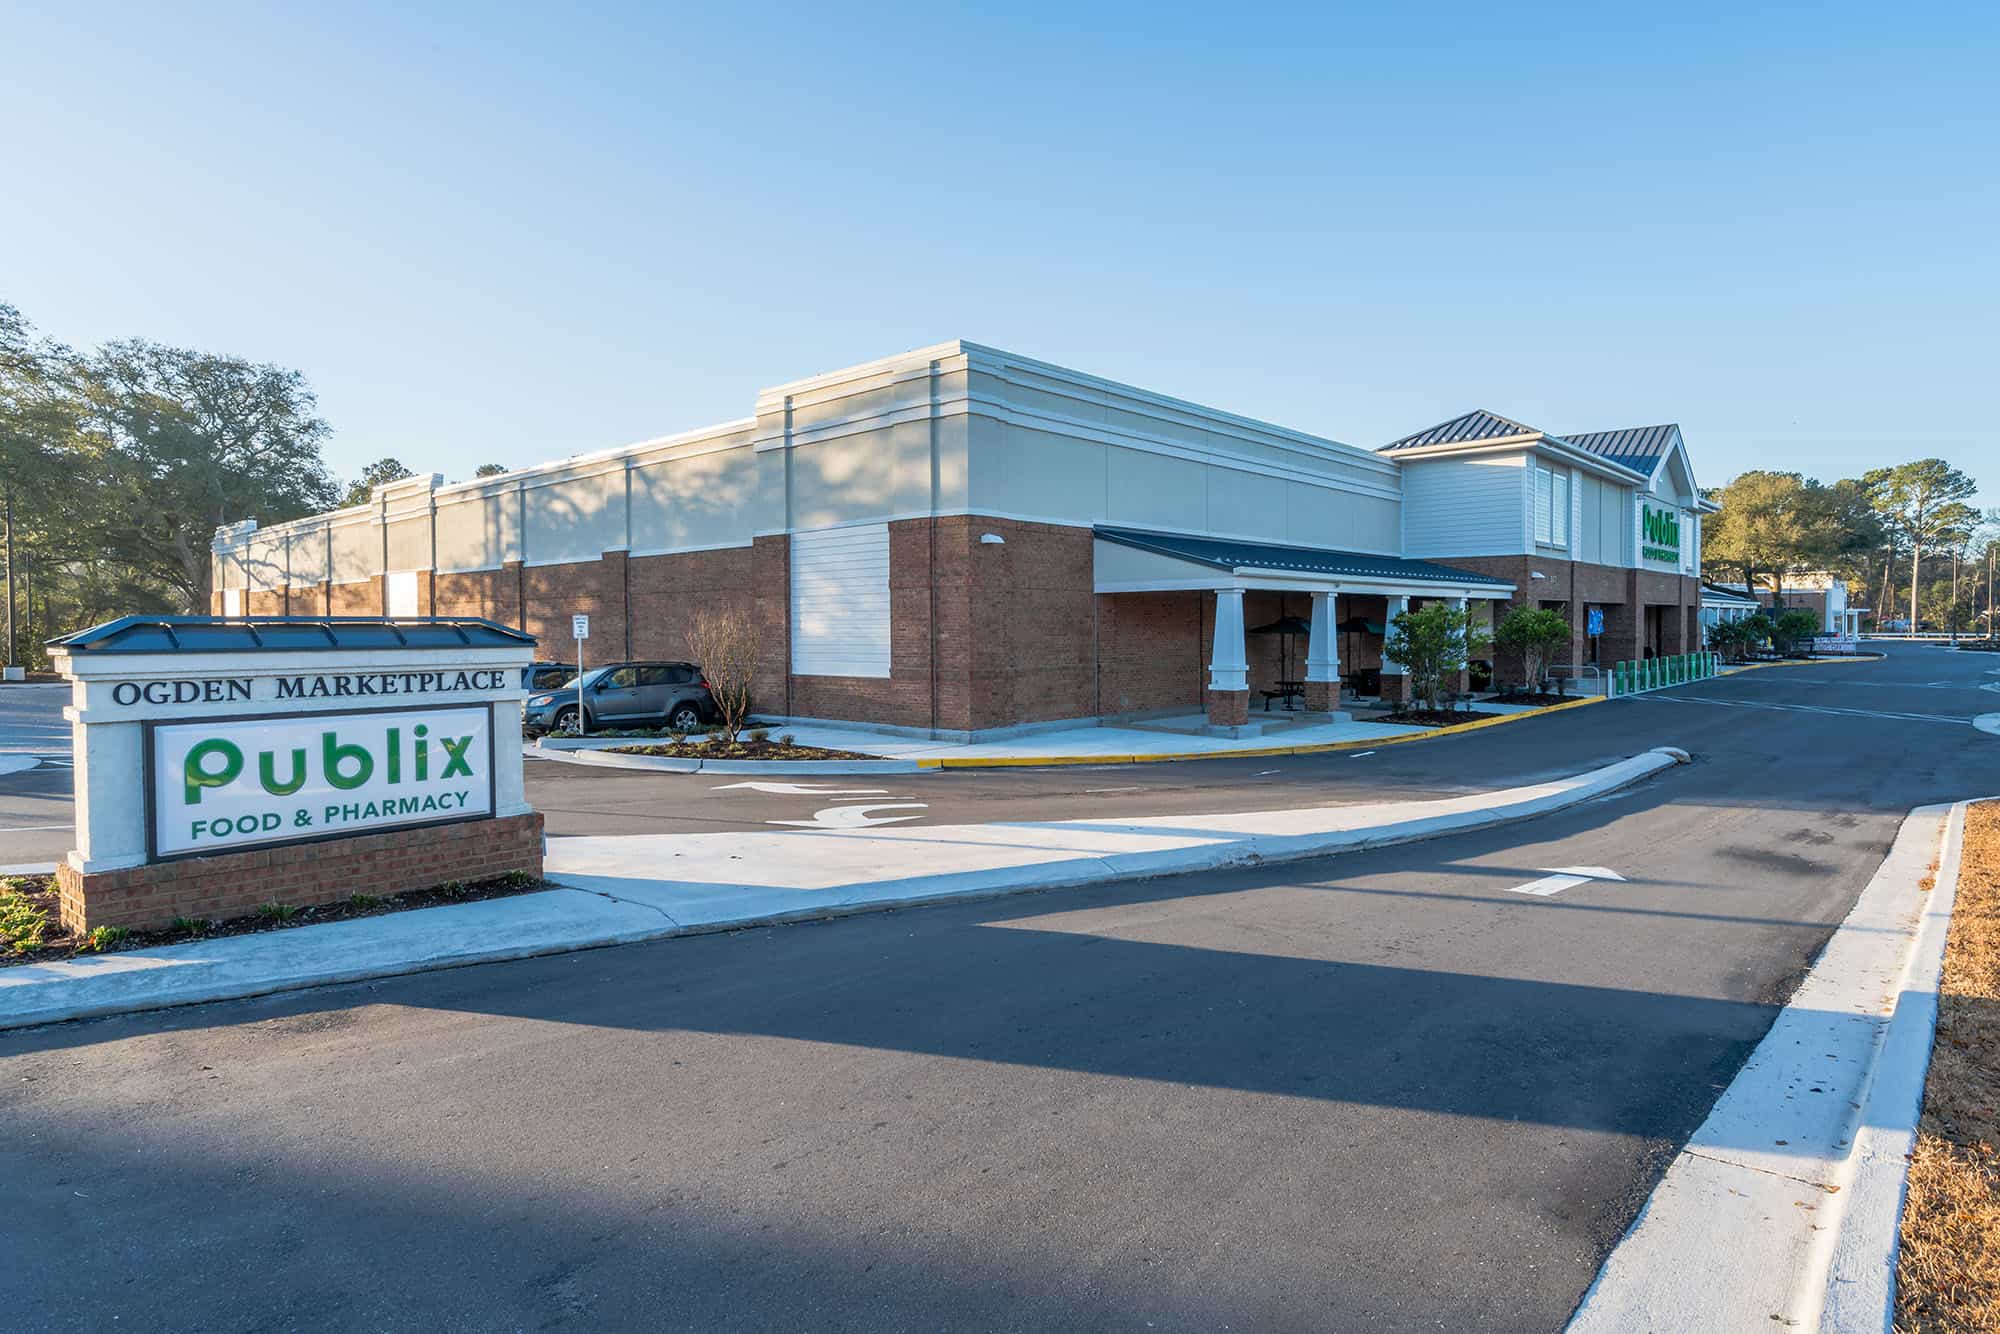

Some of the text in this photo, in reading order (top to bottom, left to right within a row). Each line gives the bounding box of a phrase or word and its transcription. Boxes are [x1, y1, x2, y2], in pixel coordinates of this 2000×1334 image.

[112, 671, 506, 706] OGDEN MARKETPLACE
[184, 724, 474, 805] Publix
[191, 791, 469, 840] FOOD & PHARMACY
